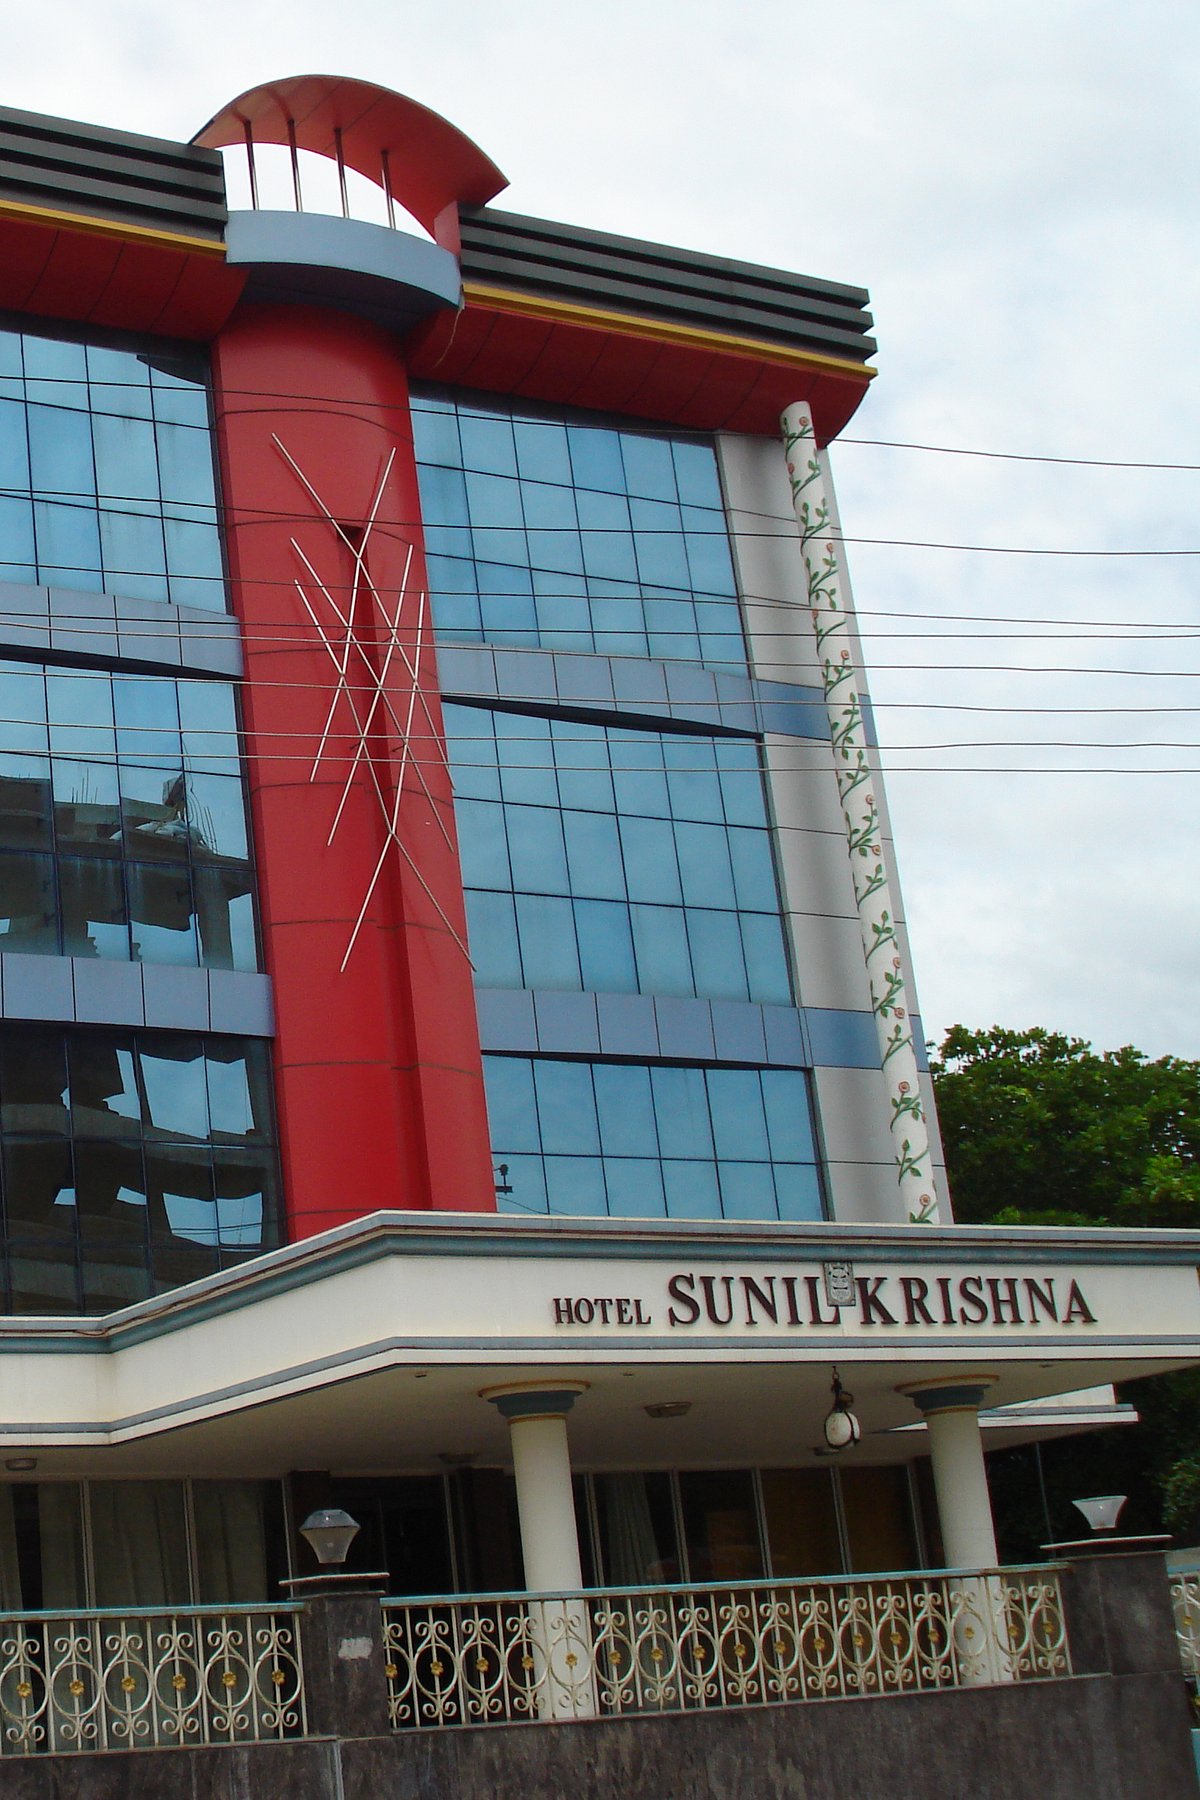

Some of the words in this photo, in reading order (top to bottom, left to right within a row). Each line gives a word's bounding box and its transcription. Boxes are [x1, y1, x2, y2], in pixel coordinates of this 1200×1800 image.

[552, 1297, 652, 1327] HOTEL
[668, 1273, 842, 1328] SUNIL
[858, 1276, 1098, 1327] KRISHNA
